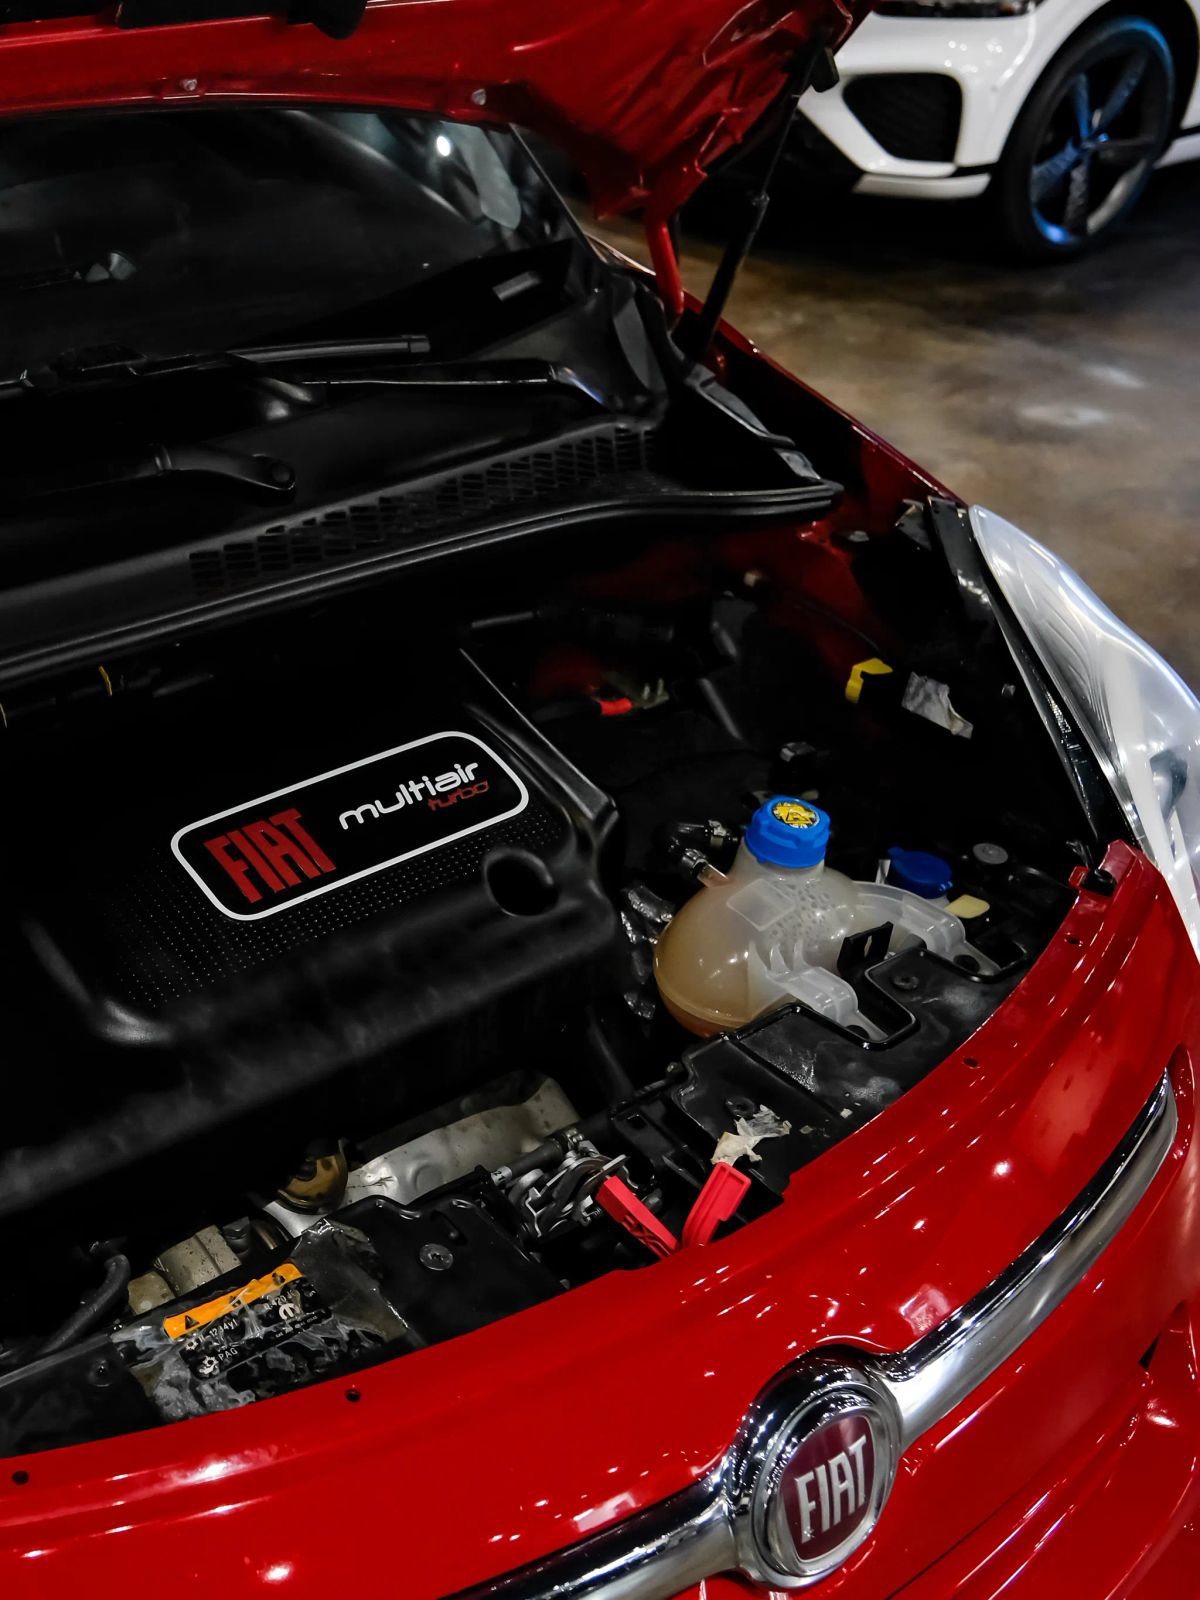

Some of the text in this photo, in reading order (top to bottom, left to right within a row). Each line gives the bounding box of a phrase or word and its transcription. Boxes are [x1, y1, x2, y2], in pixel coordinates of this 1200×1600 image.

[338, 762, 479, 830] multiair
[427, 780, 489, 811] turbo
[203, 808, 337, 903] FIAT
[794, 1435, 867, 1544] FIAT
